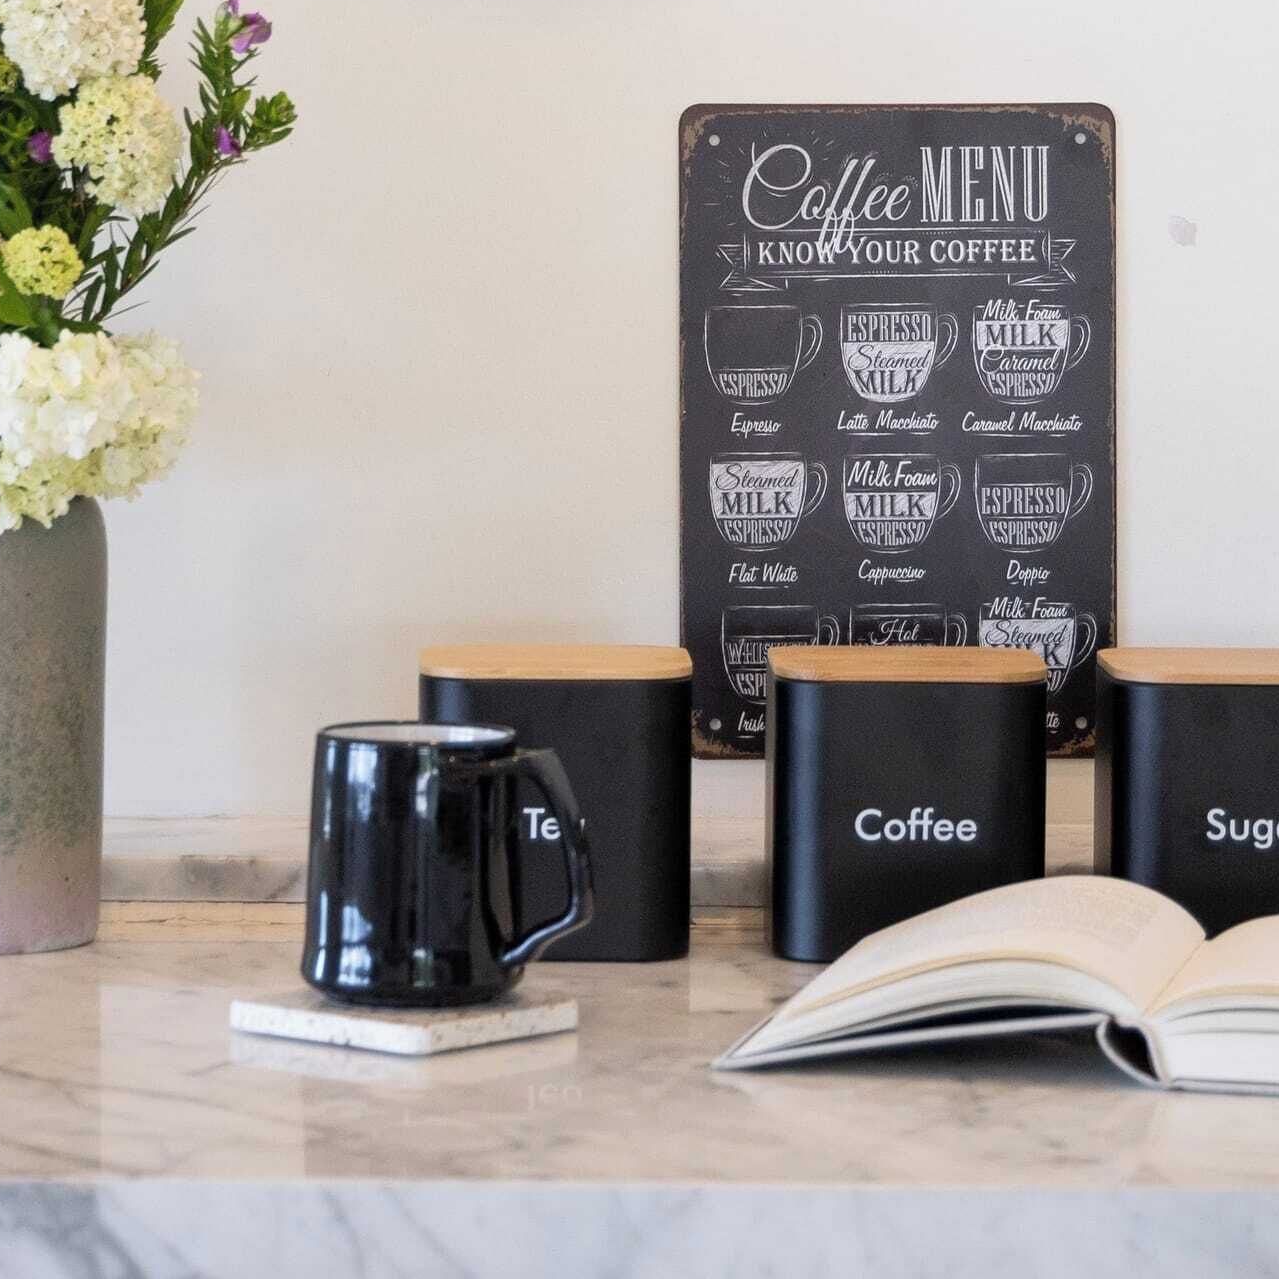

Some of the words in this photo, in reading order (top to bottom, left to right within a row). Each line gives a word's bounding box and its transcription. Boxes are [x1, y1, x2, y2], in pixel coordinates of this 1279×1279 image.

[742, 141, 912, 254] Coffee
[920, 145, 1050, 222] MENU
[758, 240, 838, 265] KNOW
[847, 239, 921, 265] YOUR
[929, 239, 1036, 263] COFFEE
[982, 299, 1020, 321] Milk
[1025, 299, 1061, 321] Foam
[847, 314, 932, 341] ESPRESSO
[984, 323, 1058, 347] MILK
[847, 344, 932, 370] Steamed
[980, 343, 1060, 375] Caramel
[719, 372, 788, 398] ESPRESSO
[852, 369, 923, 395] MILK
[986, 372, 1056, 397] ESPRESSO
[730, 412, 782, 439] Espresso
[837, 410, 869, 430] Latte
[875, 409, 940, 430] Macchiato
[962, 411, 1016, 432] Caramel
[1018, 411, 1083, 432] Macchiato
[715, 462, 799, 491] Steamed
[847, 460, 892, 487] Milk
[893, 460, 938, 487] Foam
[720, 491, 795, 516] MILK
[852, 494, 928, 519] MILK
[981, 486, 1065, 515] ESPRESSO
[723, 519, 793, 545] ESPRESSO
[856, 521, 926, 547] ESPRESSO
[989, 520, 1058, 545] ESPRESSO
[728, 562, 760, 584] Flat
[762, 562, 799, 583] White
[858, 558, 926, 585] Cappuccino
[1006, 559, 1051, 587] Doppio
[988, 596, 1026, 619] Milk
[1031, 596, 1068, 619] Foam
[870, 618, 920, 645] Hot
[985, 619, 1068, 646] Steamed
[737, 711, 766, 732] Irish
[522, 807, 586, 841] Te
[854, 807, 978, 842] Coffee
